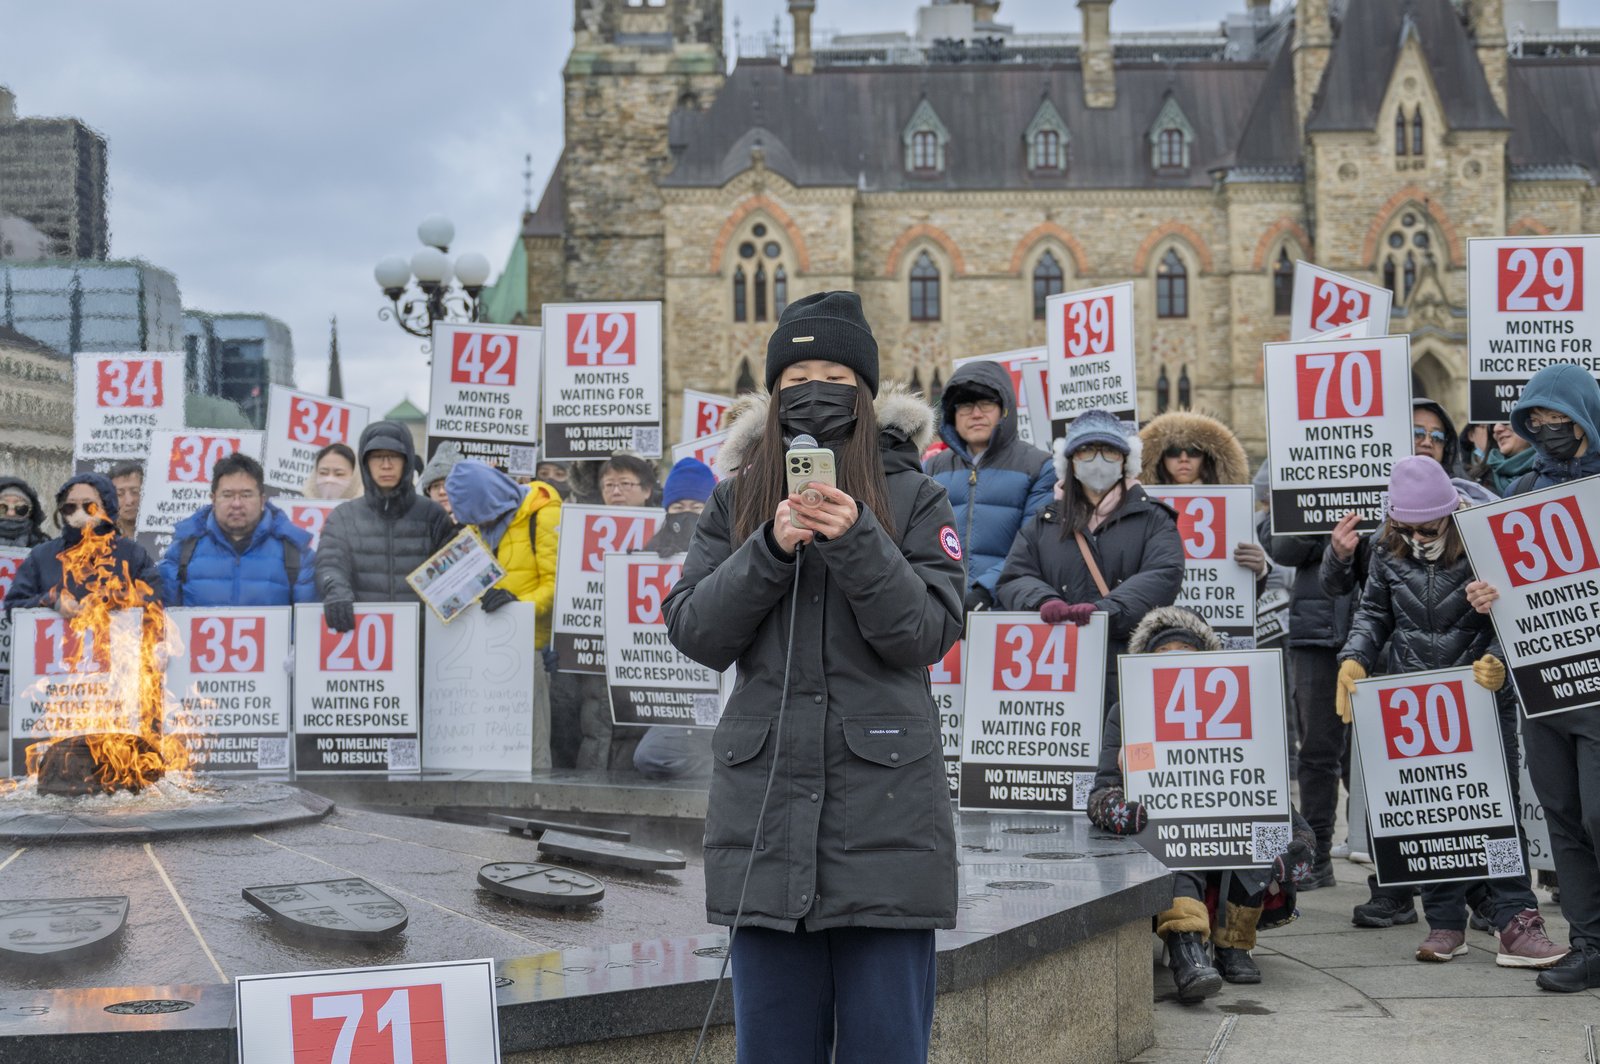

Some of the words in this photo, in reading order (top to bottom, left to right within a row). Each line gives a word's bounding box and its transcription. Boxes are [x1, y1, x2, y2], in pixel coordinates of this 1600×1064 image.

[1506, 248, 1574, 311] 29
[1315, 281, 1363, 332] 23
[1068, 298, 1109, 357] 39
[1506, 320, 1574, 334] MONTHS
[573, 313, 629, 365] 42
[1489, 340, 1556, 353] WAITING
[1561, 339, 1592, 353] FOR
[457, 334, 511, 384] 42
[1480, 358, 1514, 372] IRCC
[1070, 360, 1110, 378] MONTHS
[102, 360, 158, 407] 34
[575, 372, 629, 384] MONTHS
[1061, 379, 1100, 395] WAITING
[1103, 375, 1122, 390] FOR
[1306, 352, 1373, 418] 70
[458, 390, 510, 404] MONTHS
[561, 388, 614, 400] WAITING
[619, 388, 644, 400] FOR
[1495, 385, 1514, 398] NO
[552, 405, 581, 417] IRCC
[584, 403, 652, 416] RESPONSE
[1056, 399, 1076, 413] IRCC
[1078, 391, 1128, 409] RESPONSE
[103, 414, 157, 426] MONTHS
[445, 405, 495, 418] WAITING
[499, 409, 523, 420] FOR
[294, 400, 342, 444] 34
[436, 419, 463, 432] IRCC
[465, 421, 529, 436] RESPONSE
[565, 428, 581, 438] NO
[583, 426, 632, 439] TIMELINE
[1305, 424, 1374, 441] MONTHS
[462, 442, 511, 455] TIMELINE
[570, 440, 586, 451] NO
[1289, 444, 1356, 462] WAITING
[1362, 443, 1393, 458] FOR
[176, 436, 233, 482] 30
[1281, 465, 1315, 482] IRCC
[1318, 463, 1393, 480] RESPONS
[172, 489, 210, 500] MONT
[1297, 494, 1316, 507] NO
[1304, 509, 1322, 523] NO
[588, 516, 644, 572] 34
[1502, 501, 1585, 582] 30
[1205, 586, 1235, 600] FOR
[1525, 579, 1599, 610] MONTHS
[572, 597, 604, 611] WAIT
[562, 613, 591, 628] IRCC
[1515, 605, 1588, 634] WAITING
[197, 617, 258, 672] 35
[326, 614, 386, 670] 20
[573, 638, 590, 650] NO
[633, 632, 672, 646] MONT
[1513, 636, 1552, 658] IRCC
[577, 653, 593, 665] NO
[621, 649, 673, 663] WAITING
[677, 650, 695, 664] FO
[1001, 624, 1069, 690] 34
[615, 666, 642, 680] IRCC
[644, 667, 710, 682] RESPONSE
[1540, 666, 1562, 683] NO
[197, 680, 256, 693] MONTHS
[326, 680, 384, 692] MONTHS
[1552, 683, 1574, 699] NO
[181, 697, 240, 710] WAITING
[244, 697, 271, 709] FOR
[311, 697, 369, 709] WAITING
[374, 697, 400, 709] FOR
[630, 691, 645, 703] NO
[1164, 667, 1242, 739] 42
[636, 705, 652, 717] NO
[999, 700, 1065, 717] MONTHS
[205, 713, 280, 727] RESPONSE
[303, 714, 333, 726] IRCC
[336, 713, 408, 726] RESPONSE
[941, 714, 963, 728] FO
[1389, 683, 1461, 757] 30
[982, 720, 1046, 736] WAITING
[1051, 721, 1081, 737] FOR
[203, 738, 258, 749] TIMELINE
[317, 738, 333, 749] NO
[971, 740, 1004, 755] IRCC
[1007, 740, 1090, 758] RESPONSE
[323, 752, 339, 764] NO
[1167, 746, 1244, 766] MONTHS
[984, 769, 1004, 783] NO
[1005, 770, 1073, 785] TIMELINES
[1148, 769, 1224, 788] WAITING
[1230, 768, 1266, 785] FOR
[1399, 762, 1468, 785] MONTHS
[989, 785, 1008, 800] NO
[1011, 786, 1067, 801] RESULTS
[1138, 792, 1178, 810] IRCC
[1181, 790, 1277, 809] RESPONSE
[1385, 785, 1453, 807] WAITING
[1456, 782, 1490, 800] FOR
[1379, 810, 1415, 829] IRCC
[1417, 802, 1503, 824] RESPONSE
[1158, 824, 1179, 840] NO
[1182, 822, 1252, 839] TIMELINE
[1165, 843, 1187, 858] NO
[1399, 840, 1419, 856] NO
[1407, 856, 1428, 872] NO
[1430, 853, 1487, 871] RESULTS
[312, 988, 414, 1064] 71
